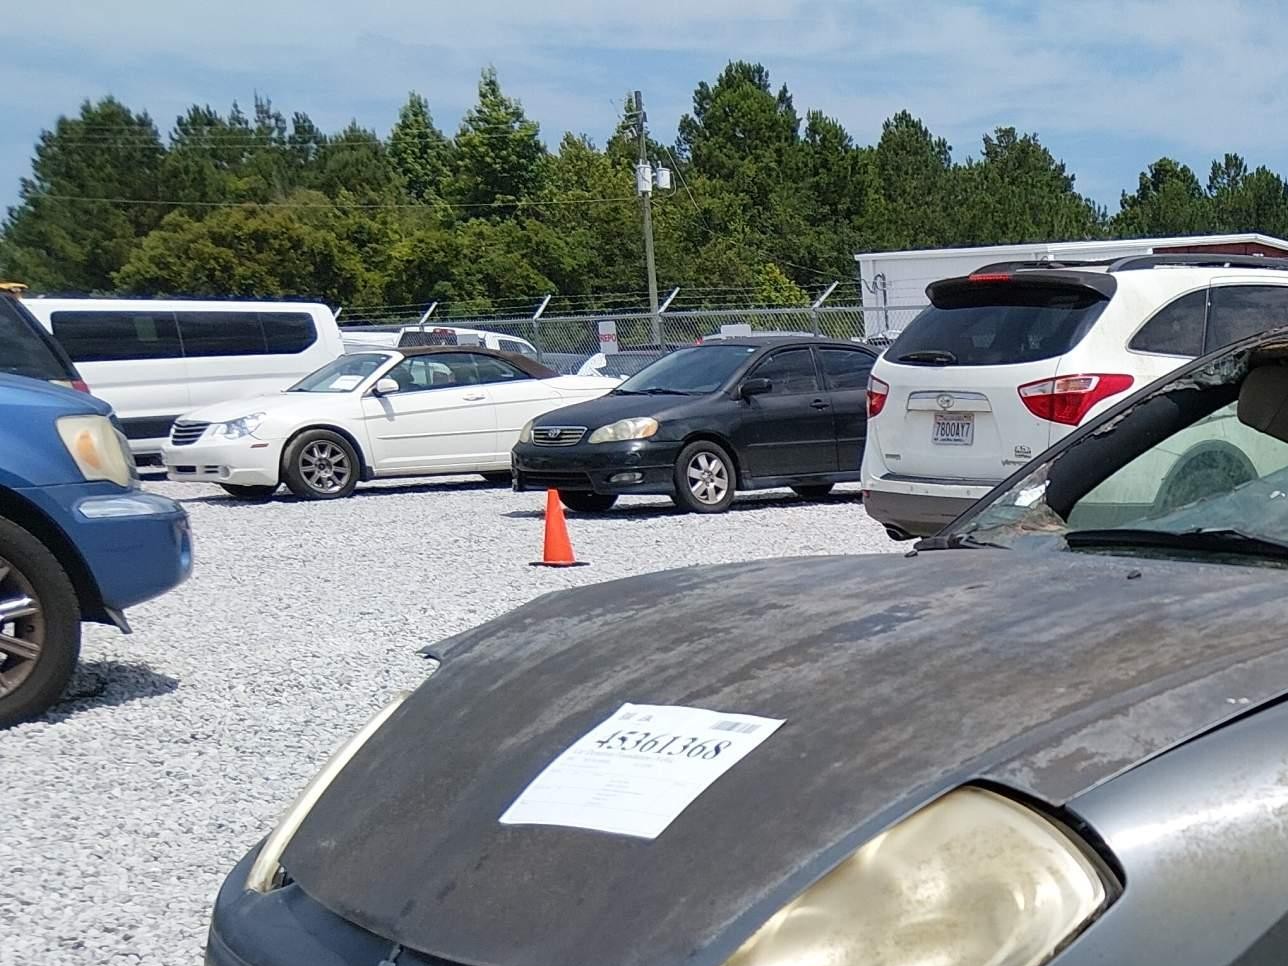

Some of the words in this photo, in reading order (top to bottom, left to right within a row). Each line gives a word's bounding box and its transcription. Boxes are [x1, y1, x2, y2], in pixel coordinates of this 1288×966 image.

[599, 334, 617, 343] REPO
[935, 421, 971, 438] 7800AY7
[595, 730, 732, 760] 45361368
